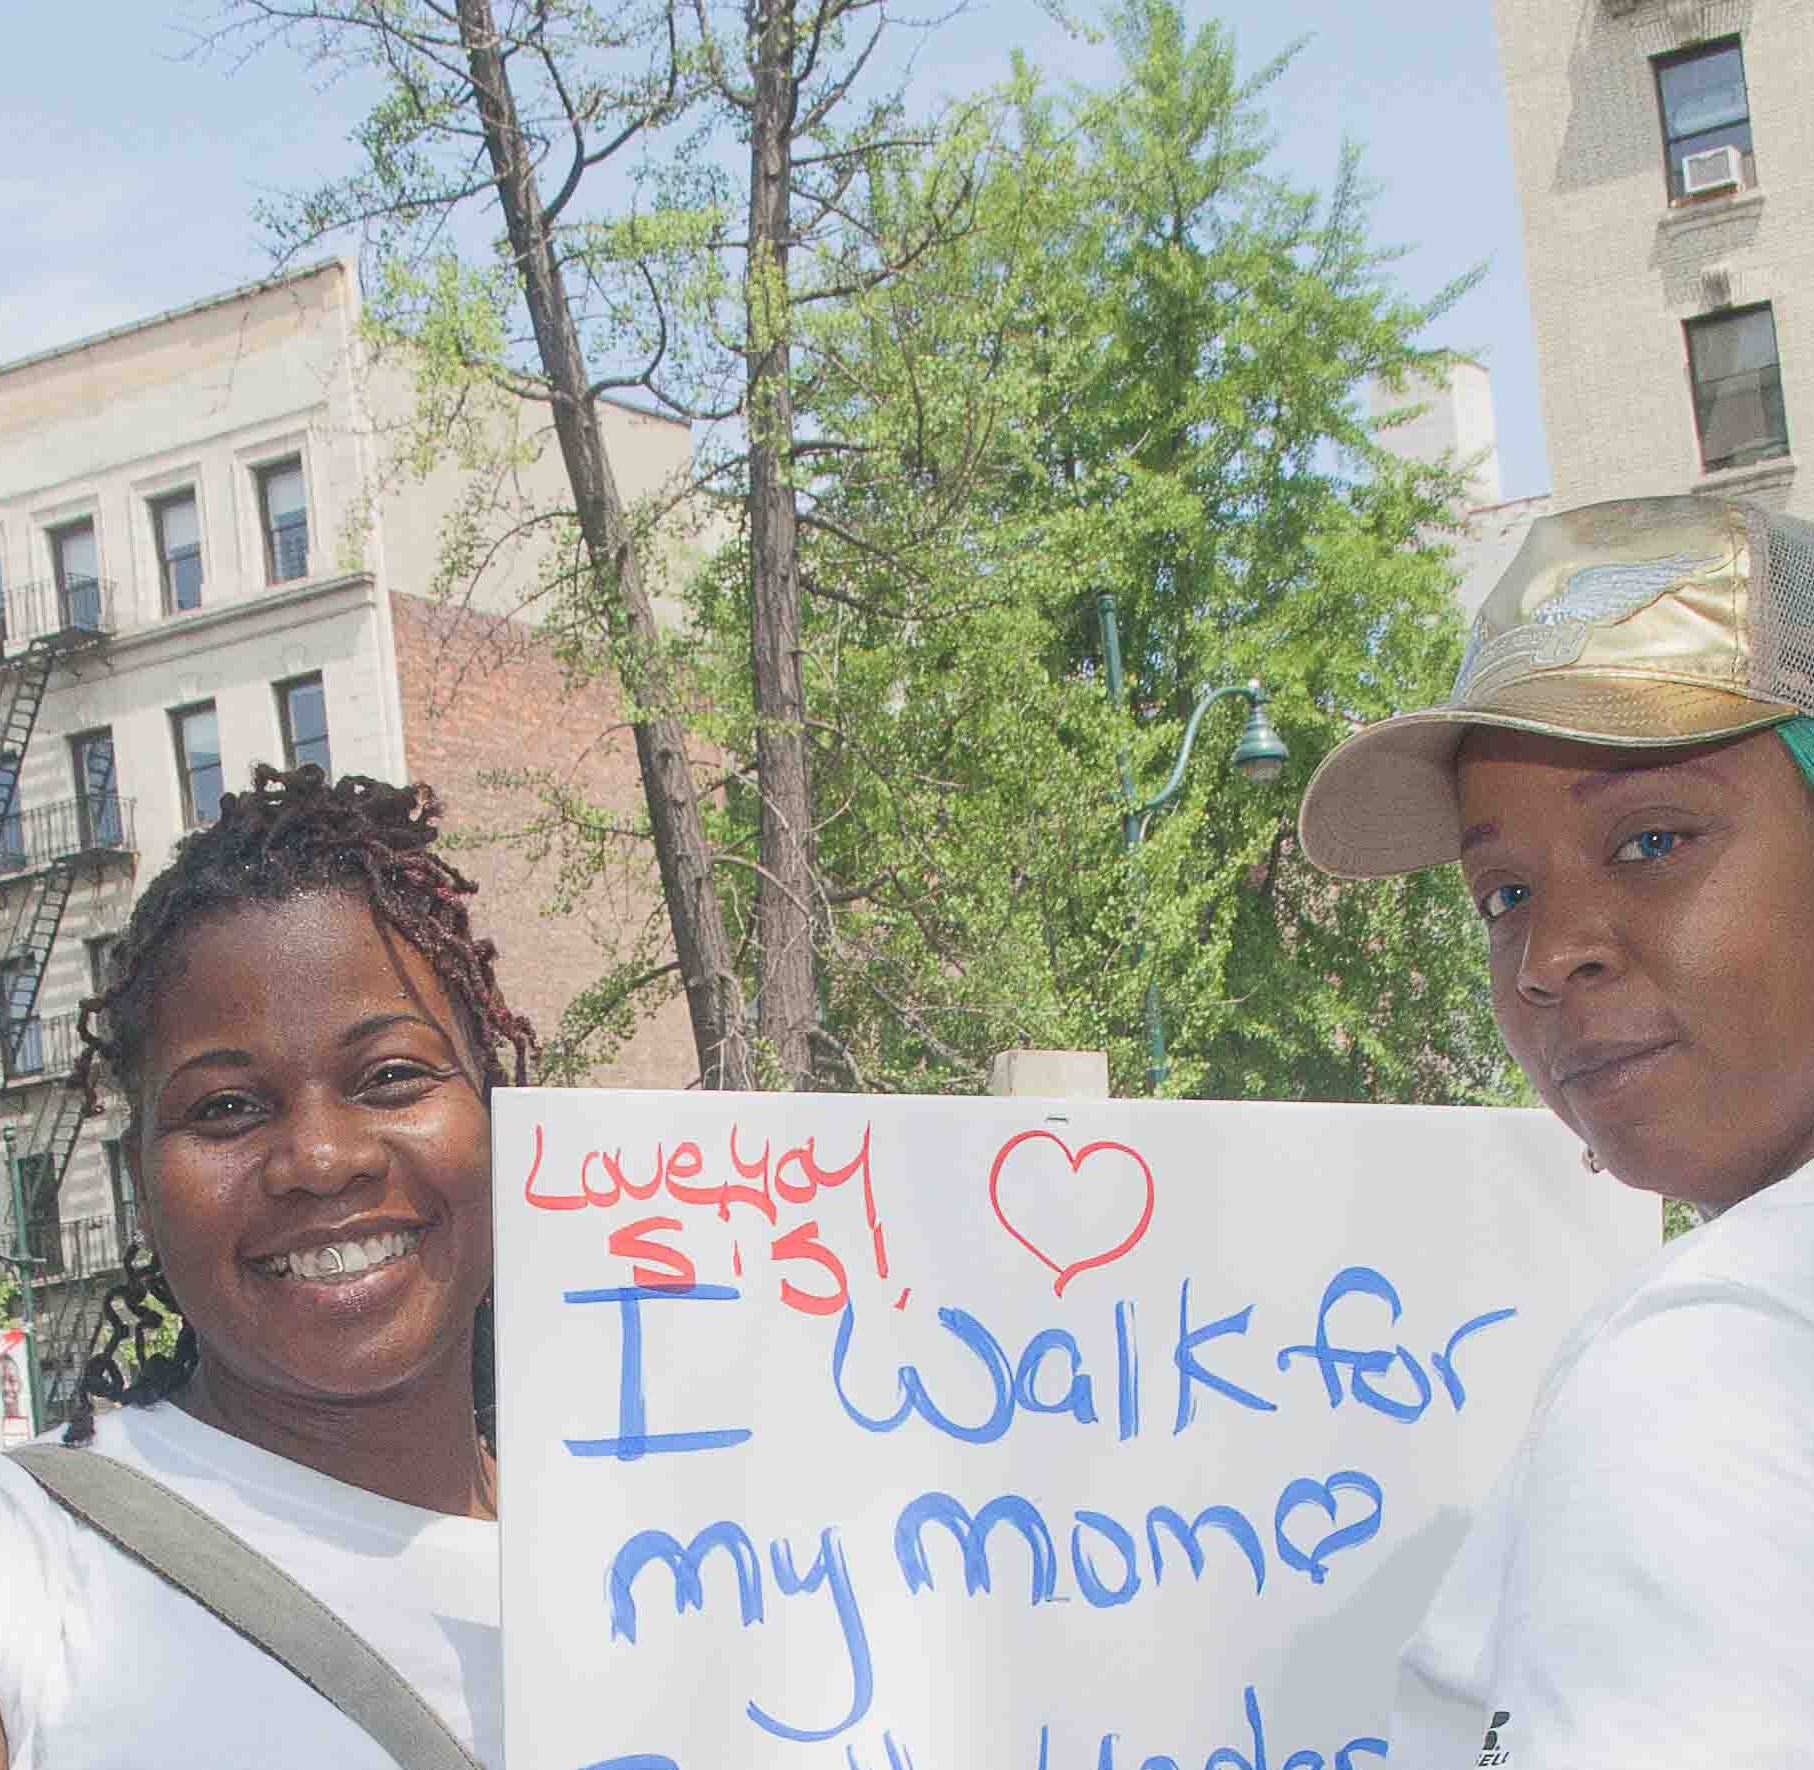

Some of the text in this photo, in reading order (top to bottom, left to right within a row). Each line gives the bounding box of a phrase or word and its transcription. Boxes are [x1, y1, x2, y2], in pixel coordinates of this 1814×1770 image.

[562, 1283, 753, 1462] I
[1277, 1266, 1519, 1425] for
[609, 1519, 875, 1743] my
